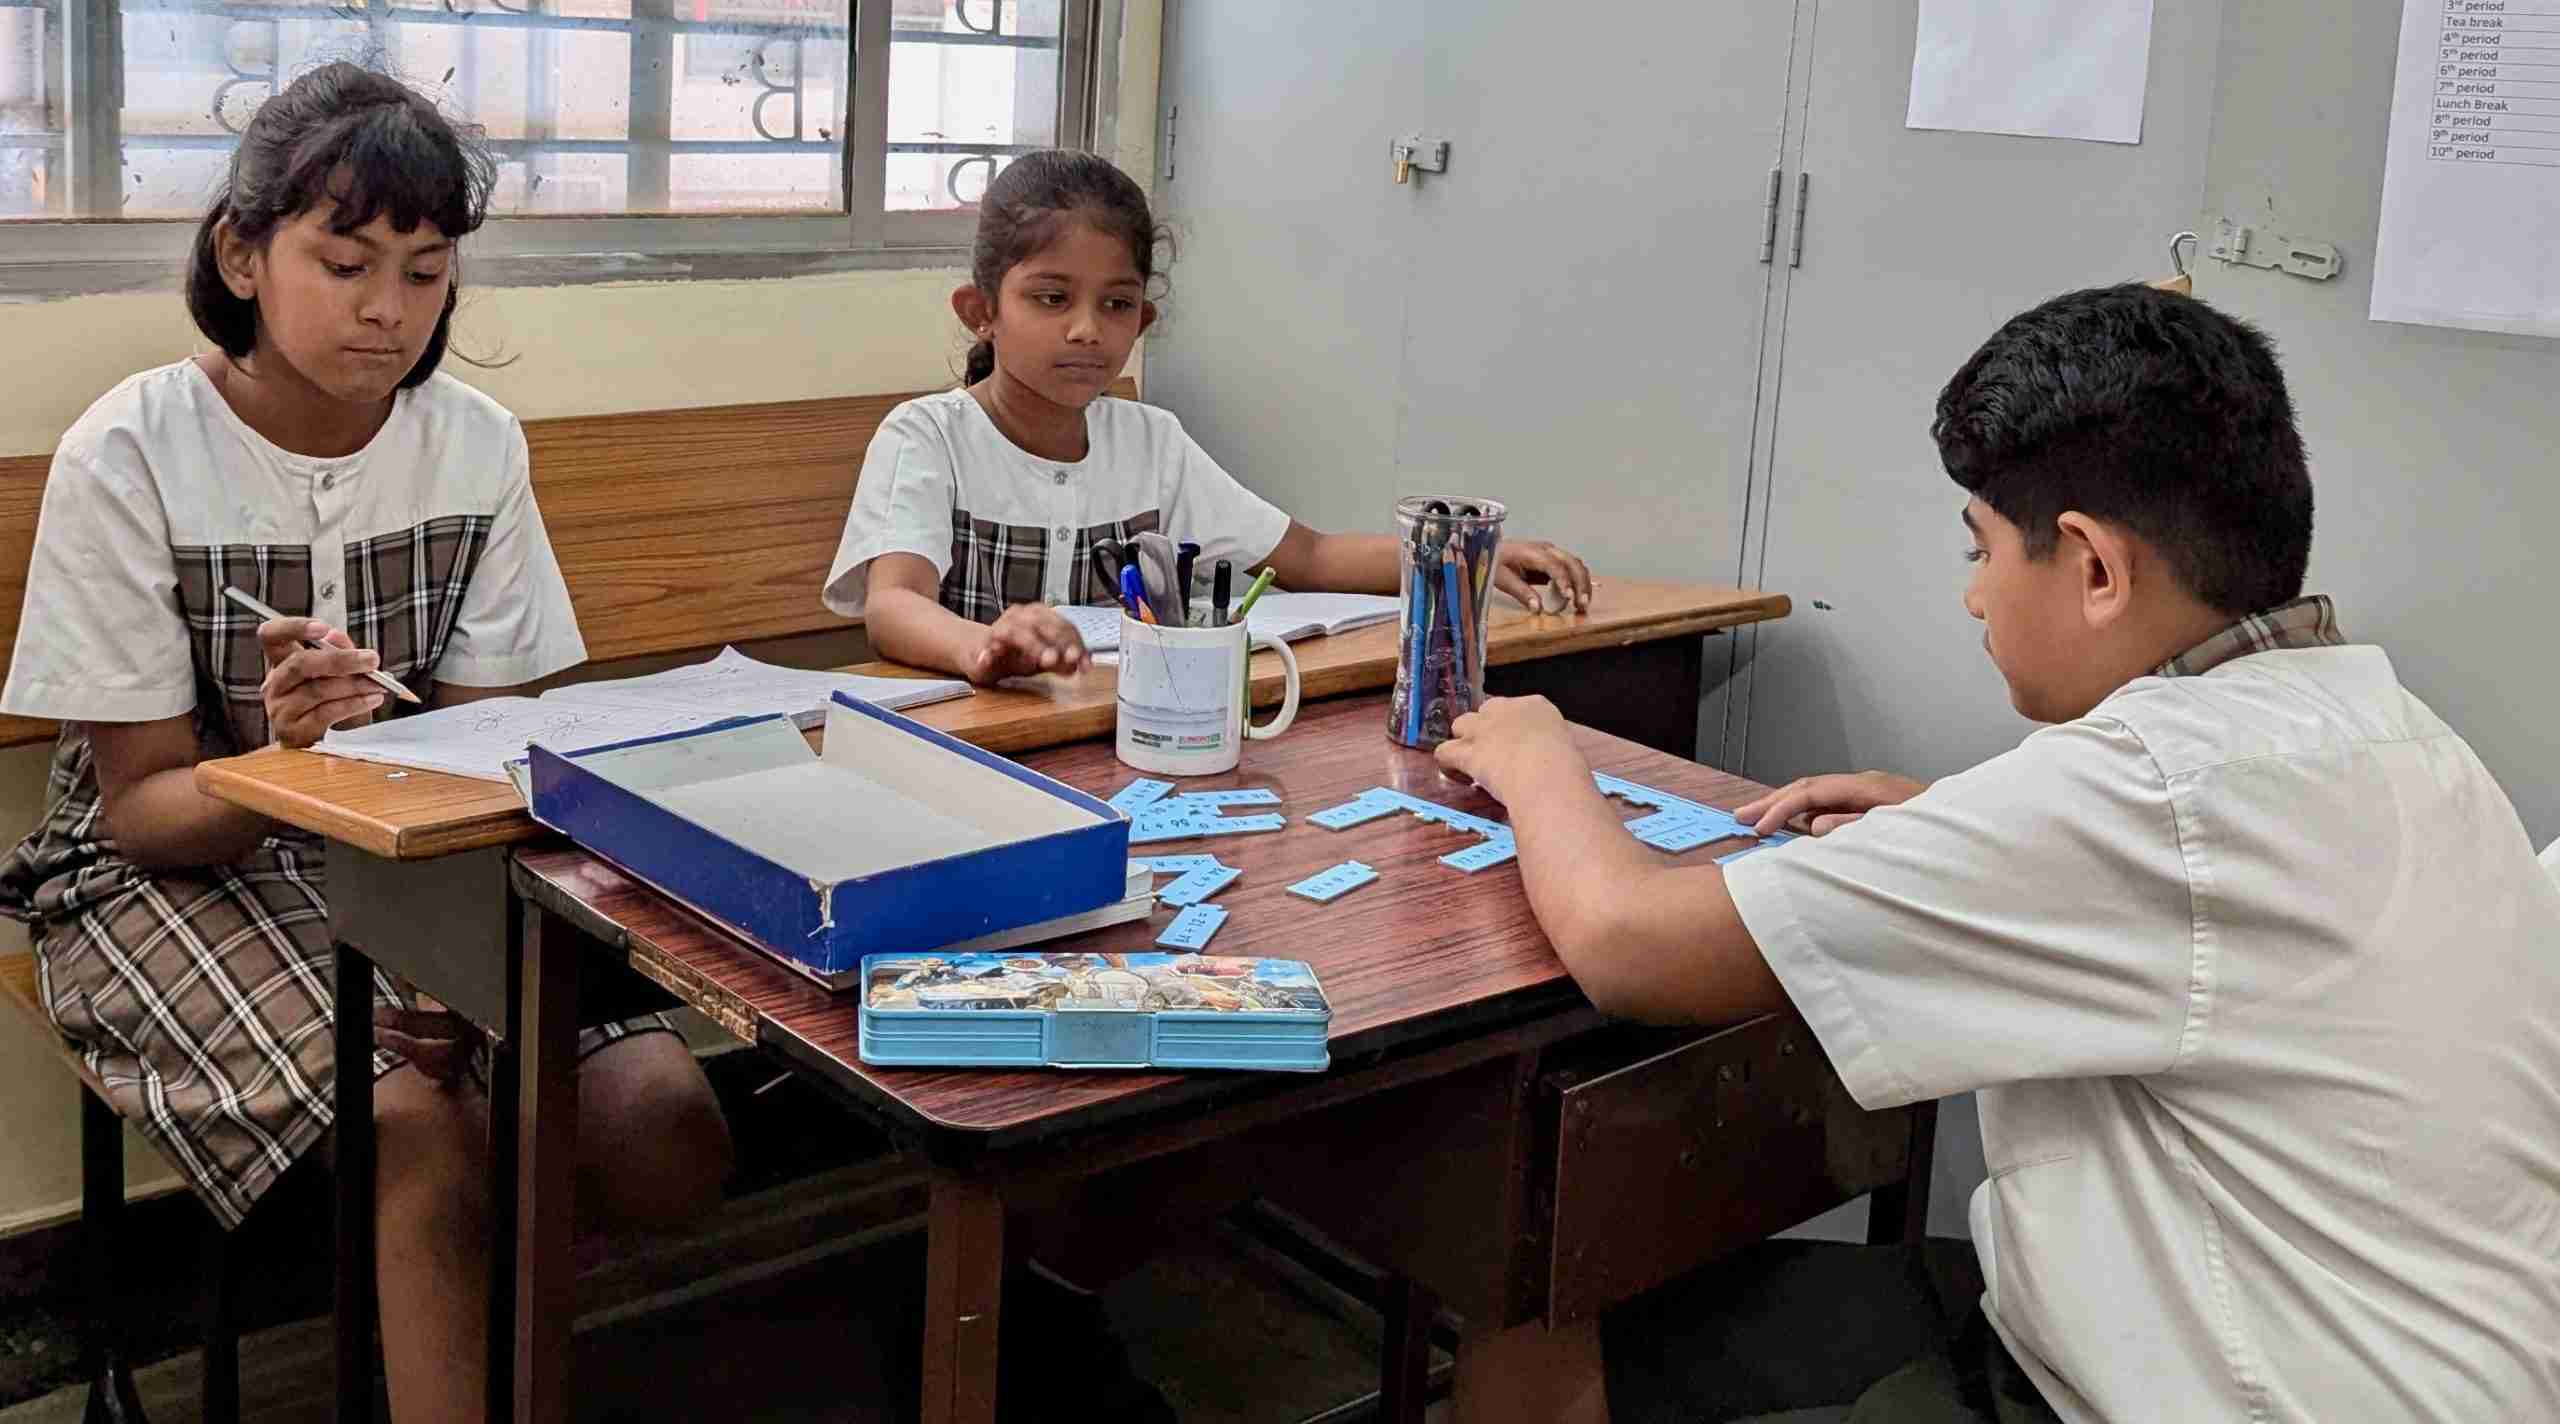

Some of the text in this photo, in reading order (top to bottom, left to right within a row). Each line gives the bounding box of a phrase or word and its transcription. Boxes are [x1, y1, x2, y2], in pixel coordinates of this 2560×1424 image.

[2465, 0, 2504, 12] period
[2446, 16, 2503, 28] Tea break
[2462, 33, 2501, 45] period
[2460, 50, 2499, 62] period
[2458, 66, 2497, 78] period
[2456, 83, 2495, 95] period
[2436, 98, 2509, 111] Lunch Break
[2452, 115, 2491, 127] period
[2450, 132, 2489, 144] period
[2455, 149, 2495, 160] period
